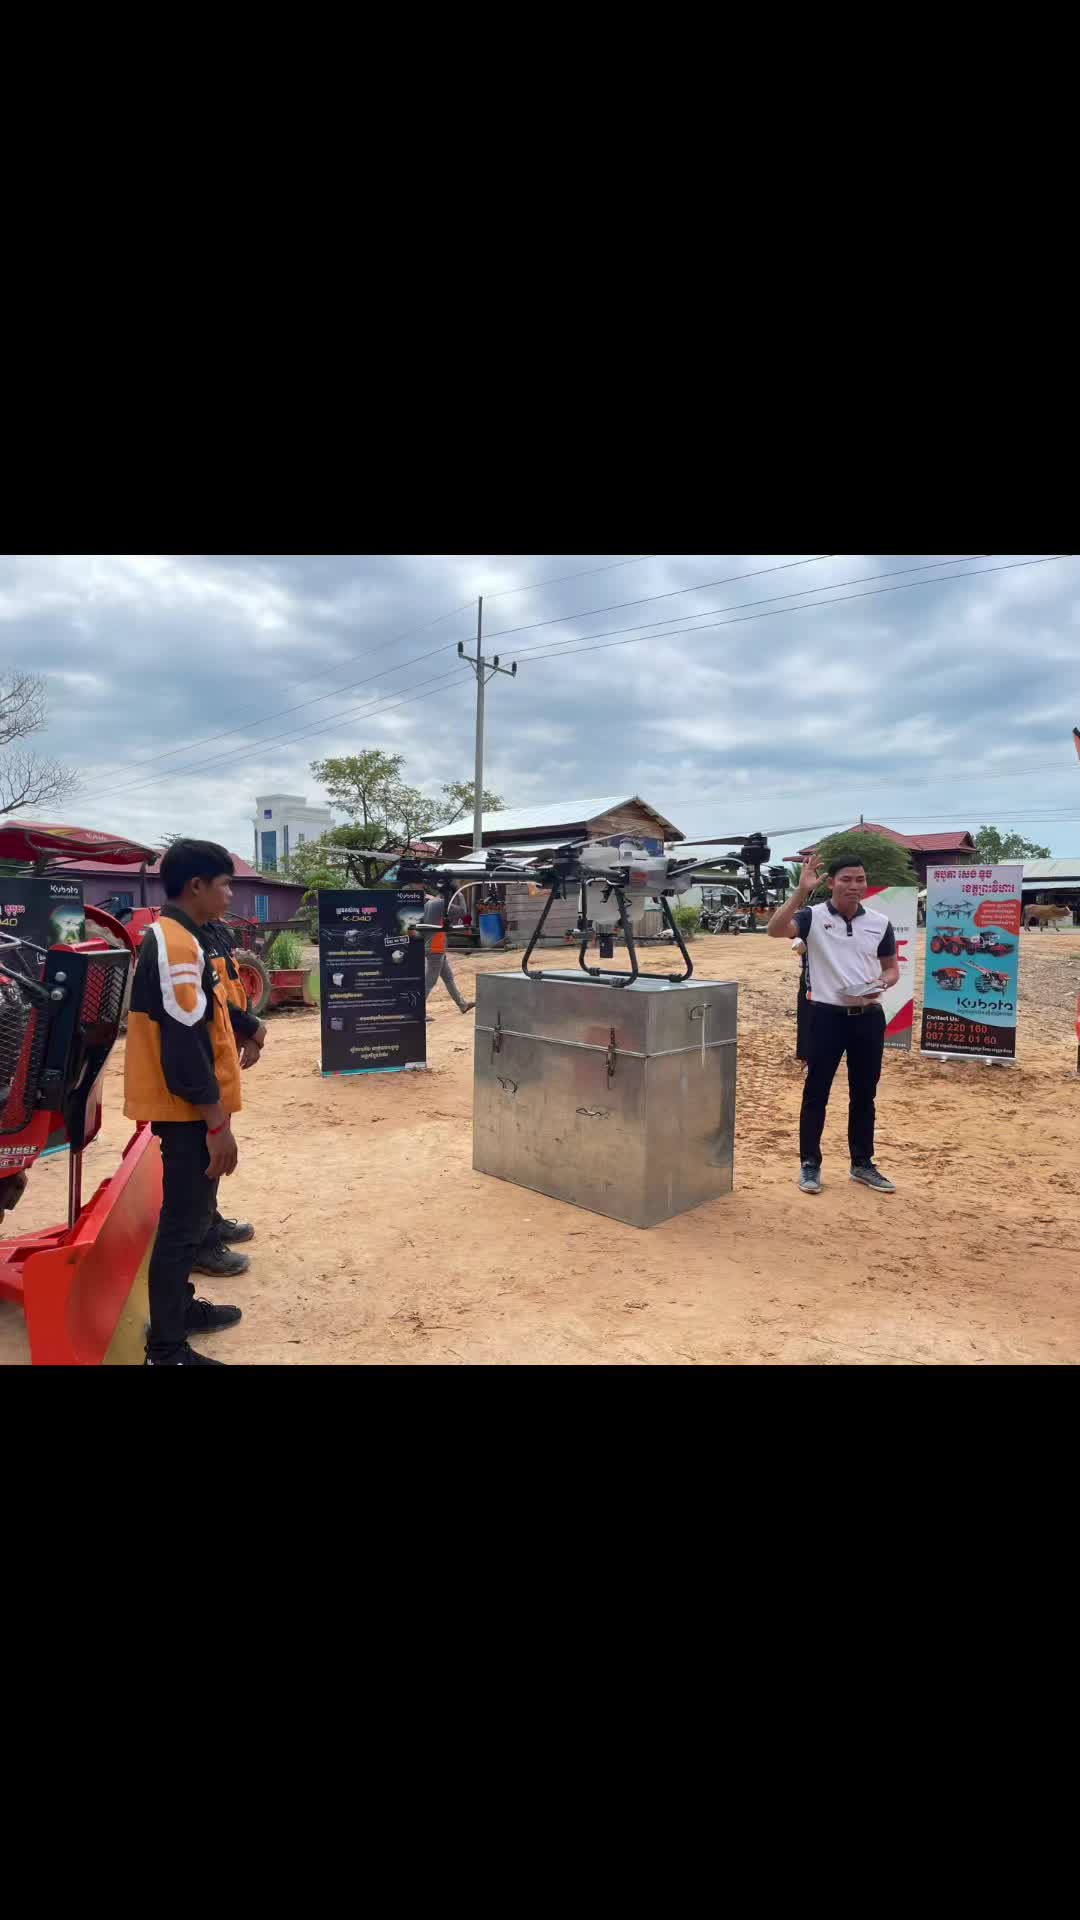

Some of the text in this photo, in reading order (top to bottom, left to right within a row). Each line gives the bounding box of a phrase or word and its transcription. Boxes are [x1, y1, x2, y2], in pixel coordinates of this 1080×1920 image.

[50, 884, 79, 894] Kubota
[957, 997, 1014, 1011] Kubota
[926, 1022, 988, 1034] 012 220 160
[947, 1032, 966, 1043] 722
[968, 1034, 980, 1044] 01
[983, 1036, 997, 1045] 60
